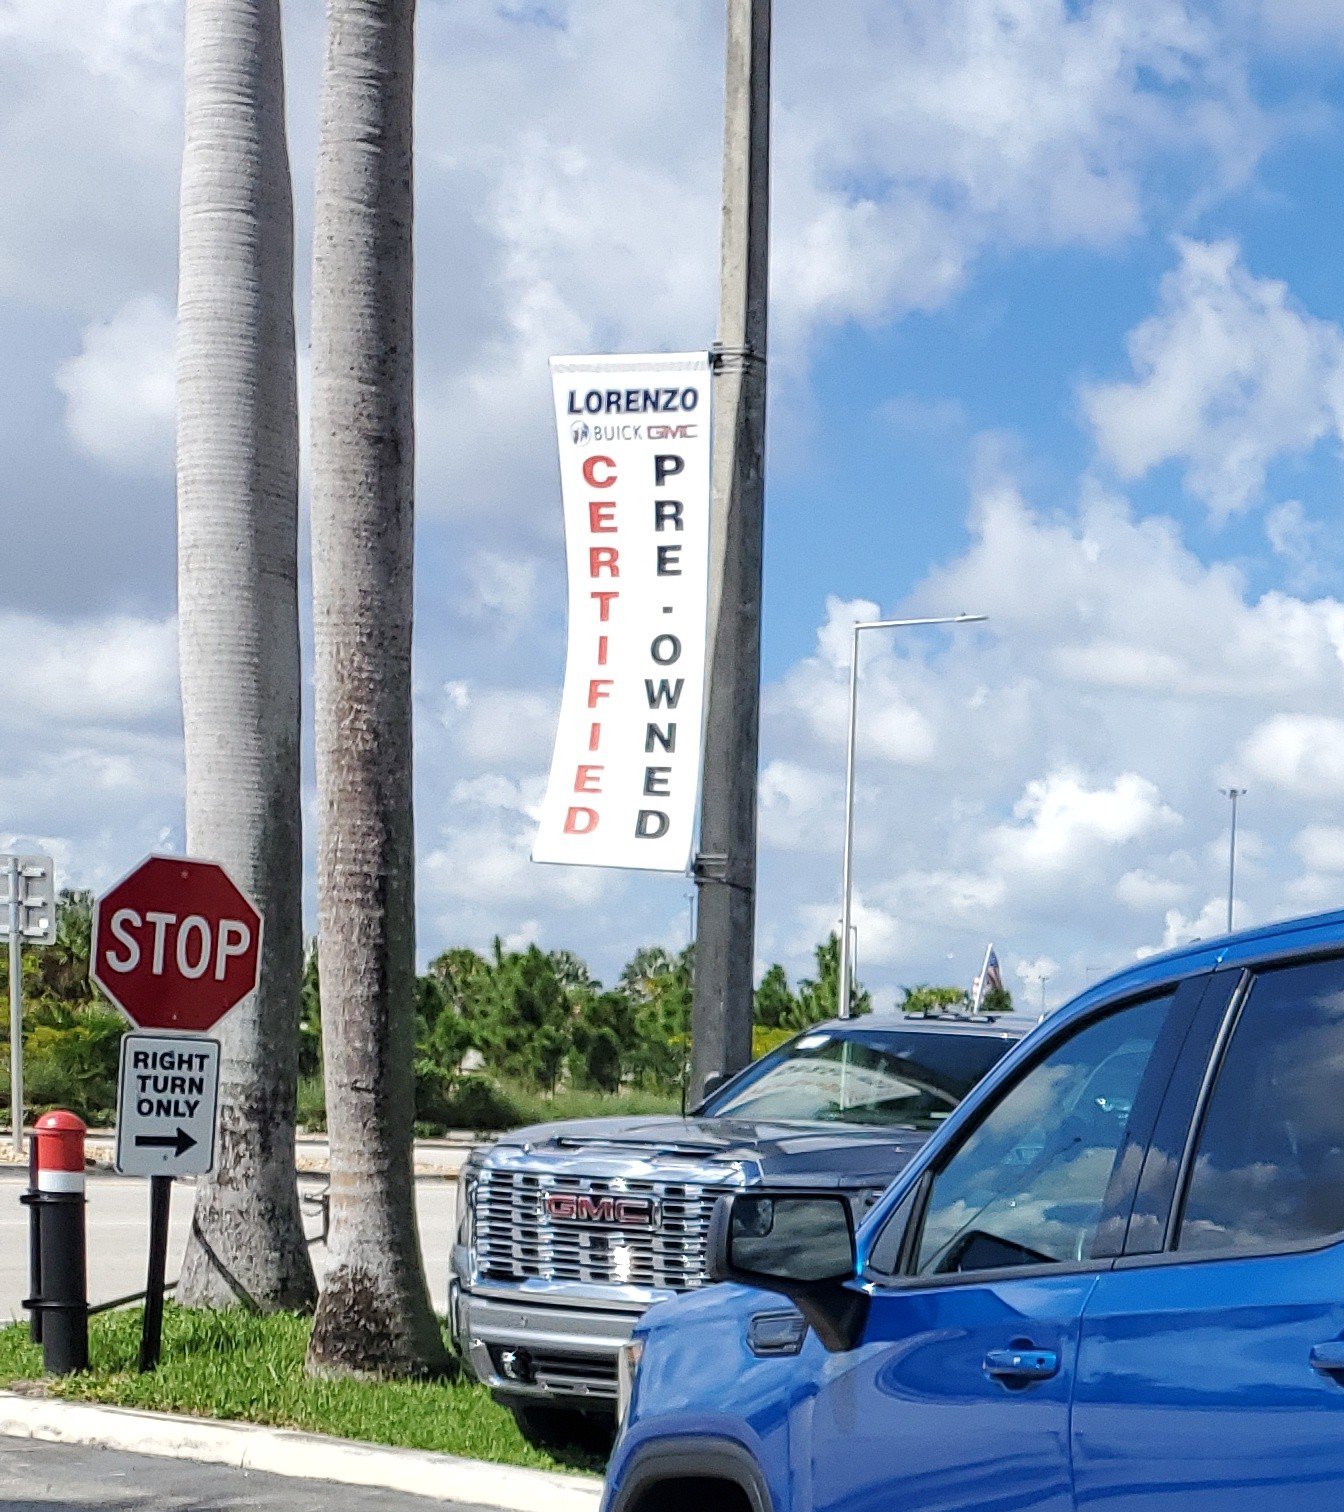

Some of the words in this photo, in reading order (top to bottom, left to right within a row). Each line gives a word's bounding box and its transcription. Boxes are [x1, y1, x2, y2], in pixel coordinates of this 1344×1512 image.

[567, 388, 699, 415] LORENZO
[594, 425, 642, 441] BUICK
[647, 424, 698, 440] GMC
[563, 455, 620, 835] CERTIFIED
[106, 908, 251, 981] STOP
[133, 1051, 210, 1072] RIGHT
[137, 1075, 204, 1095] TURN
[137, 1099, 200, 1118] ONLY
[548, 1194, 650, 1223] GMC
